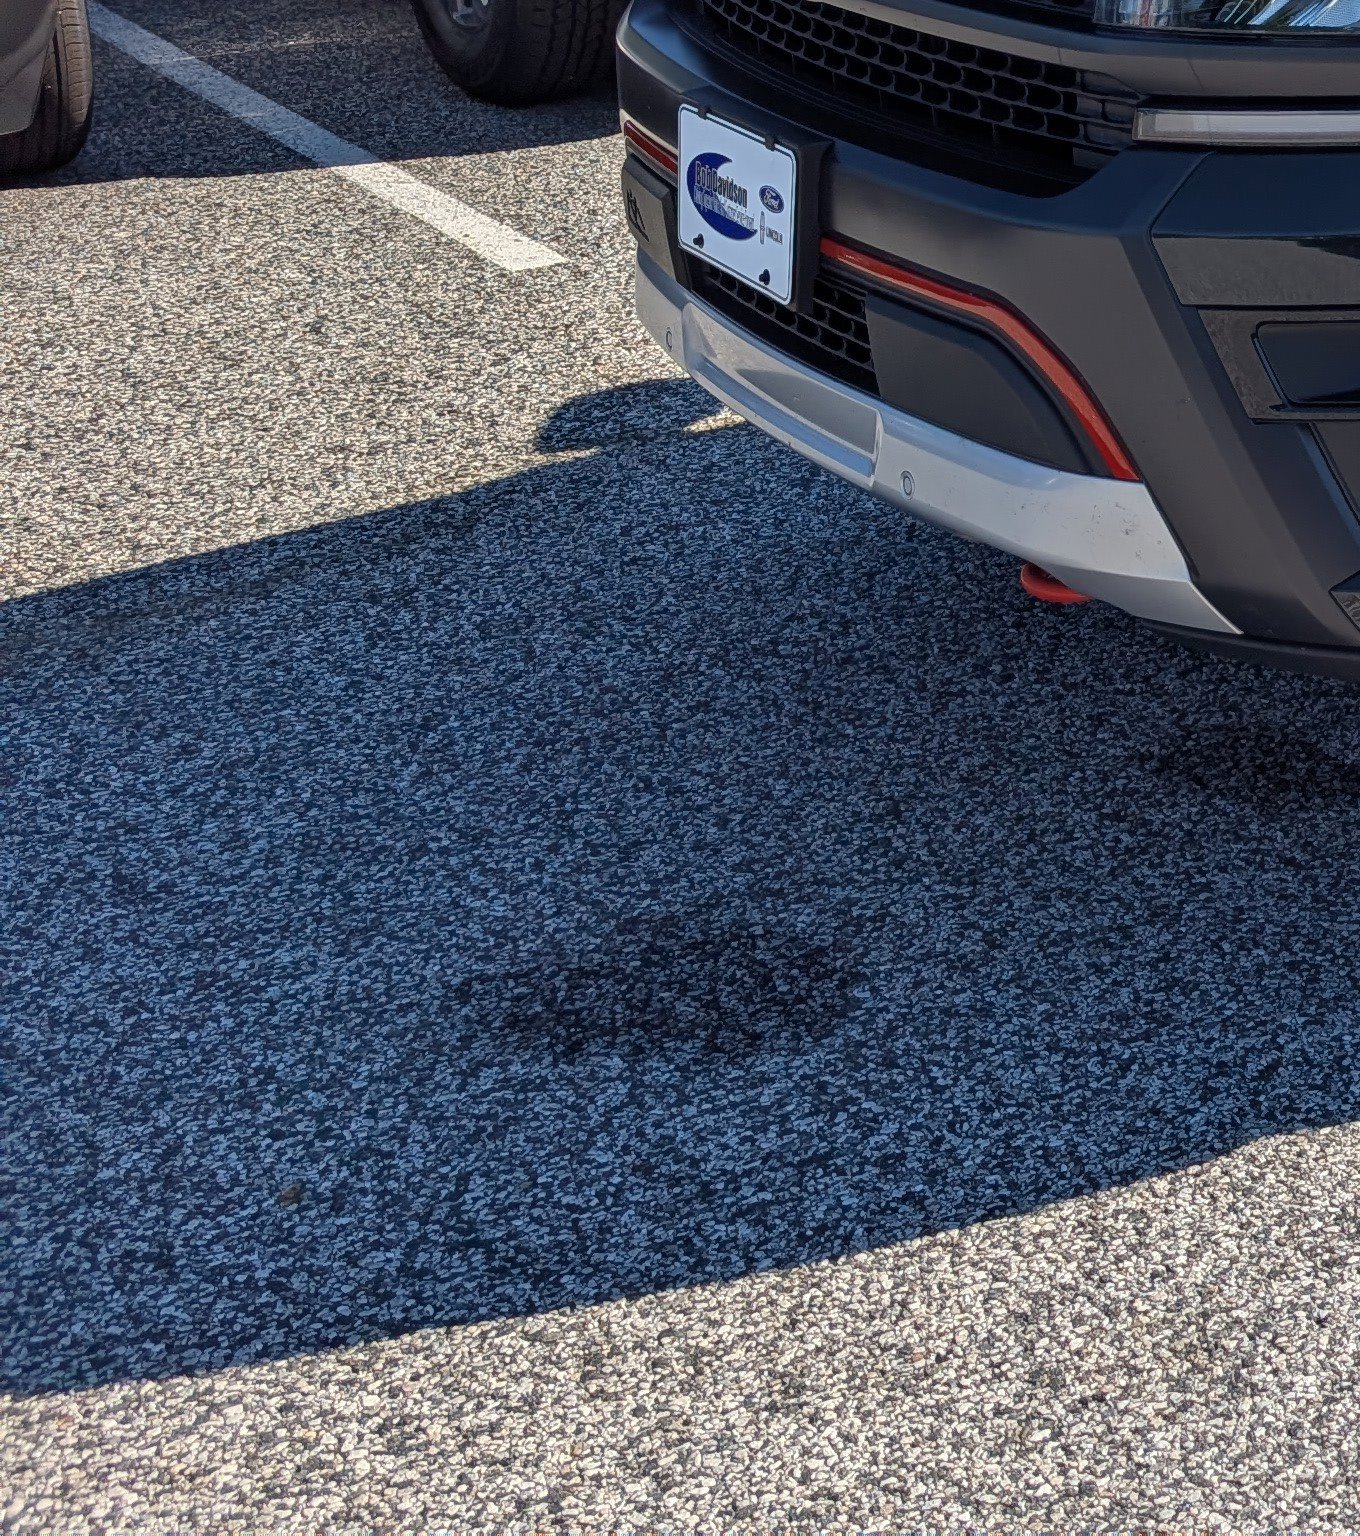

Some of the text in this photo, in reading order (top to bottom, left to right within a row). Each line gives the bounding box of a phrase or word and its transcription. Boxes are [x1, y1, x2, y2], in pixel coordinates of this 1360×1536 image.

[695, 161, 712, 190] Bob
[711, 167, 748, 209] Davidson
[762, 187, 781, 211] Ford
